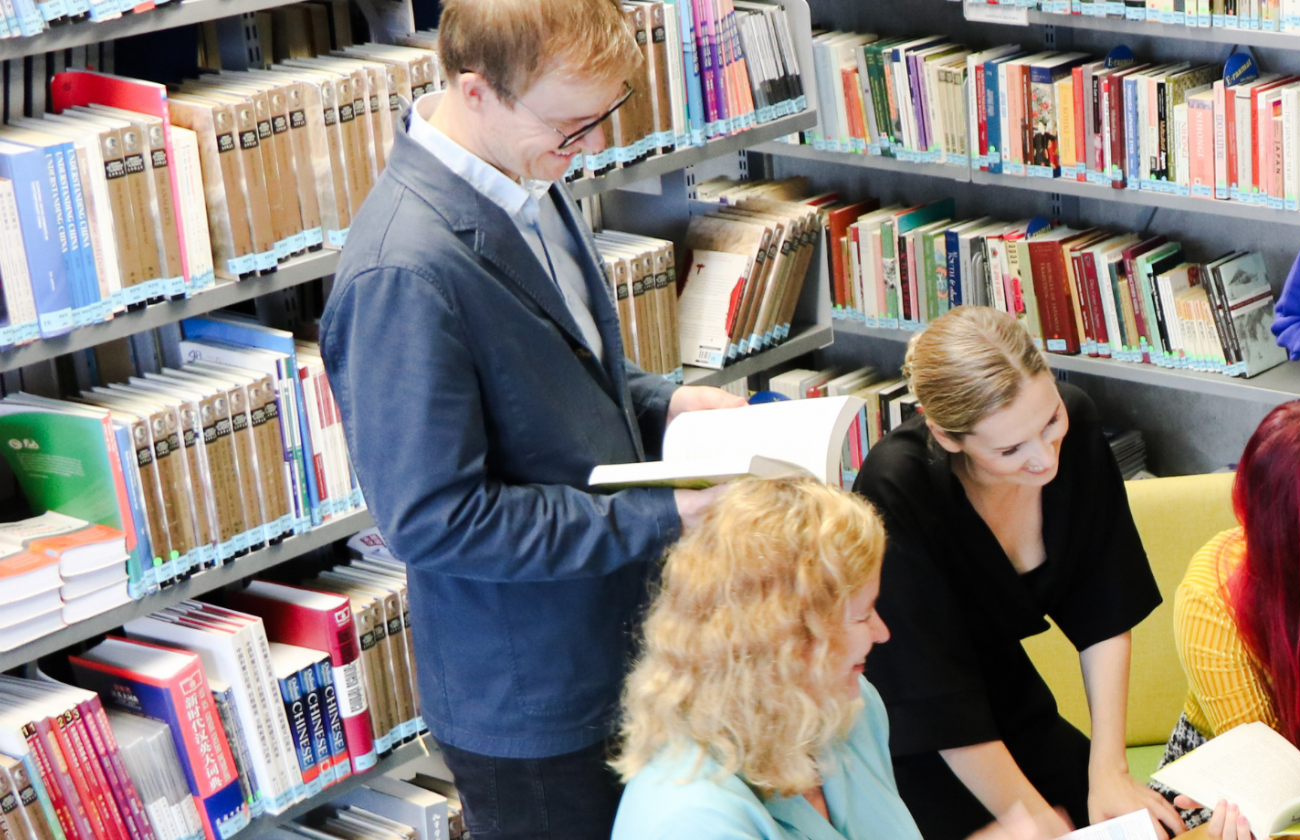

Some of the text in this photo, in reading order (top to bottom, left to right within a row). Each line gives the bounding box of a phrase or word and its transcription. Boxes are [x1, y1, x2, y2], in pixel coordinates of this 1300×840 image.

[45, 154, 69, 254] UNDERSTANDING CHINA
[56, 151, 80, 252] UNDERSTANDING CHINA
[67, 148, 92, 248] UNDERSTANDING CHINA
[1040, 262, 1048, 299] TRADITION
[1052, 303, 1060, 332] JAPANESE
[58, 718, 64, 727] 2
[65, 710, 72, 721] 3
[74, 708, 80, 718] 3
[185, 692, 222, 792] 新时代汉英大词典
[292, 701, 314, 766] CHINESE
[308, 692, 328, 758] CHINESE
[324, 686, 346, 751] CHINESE
